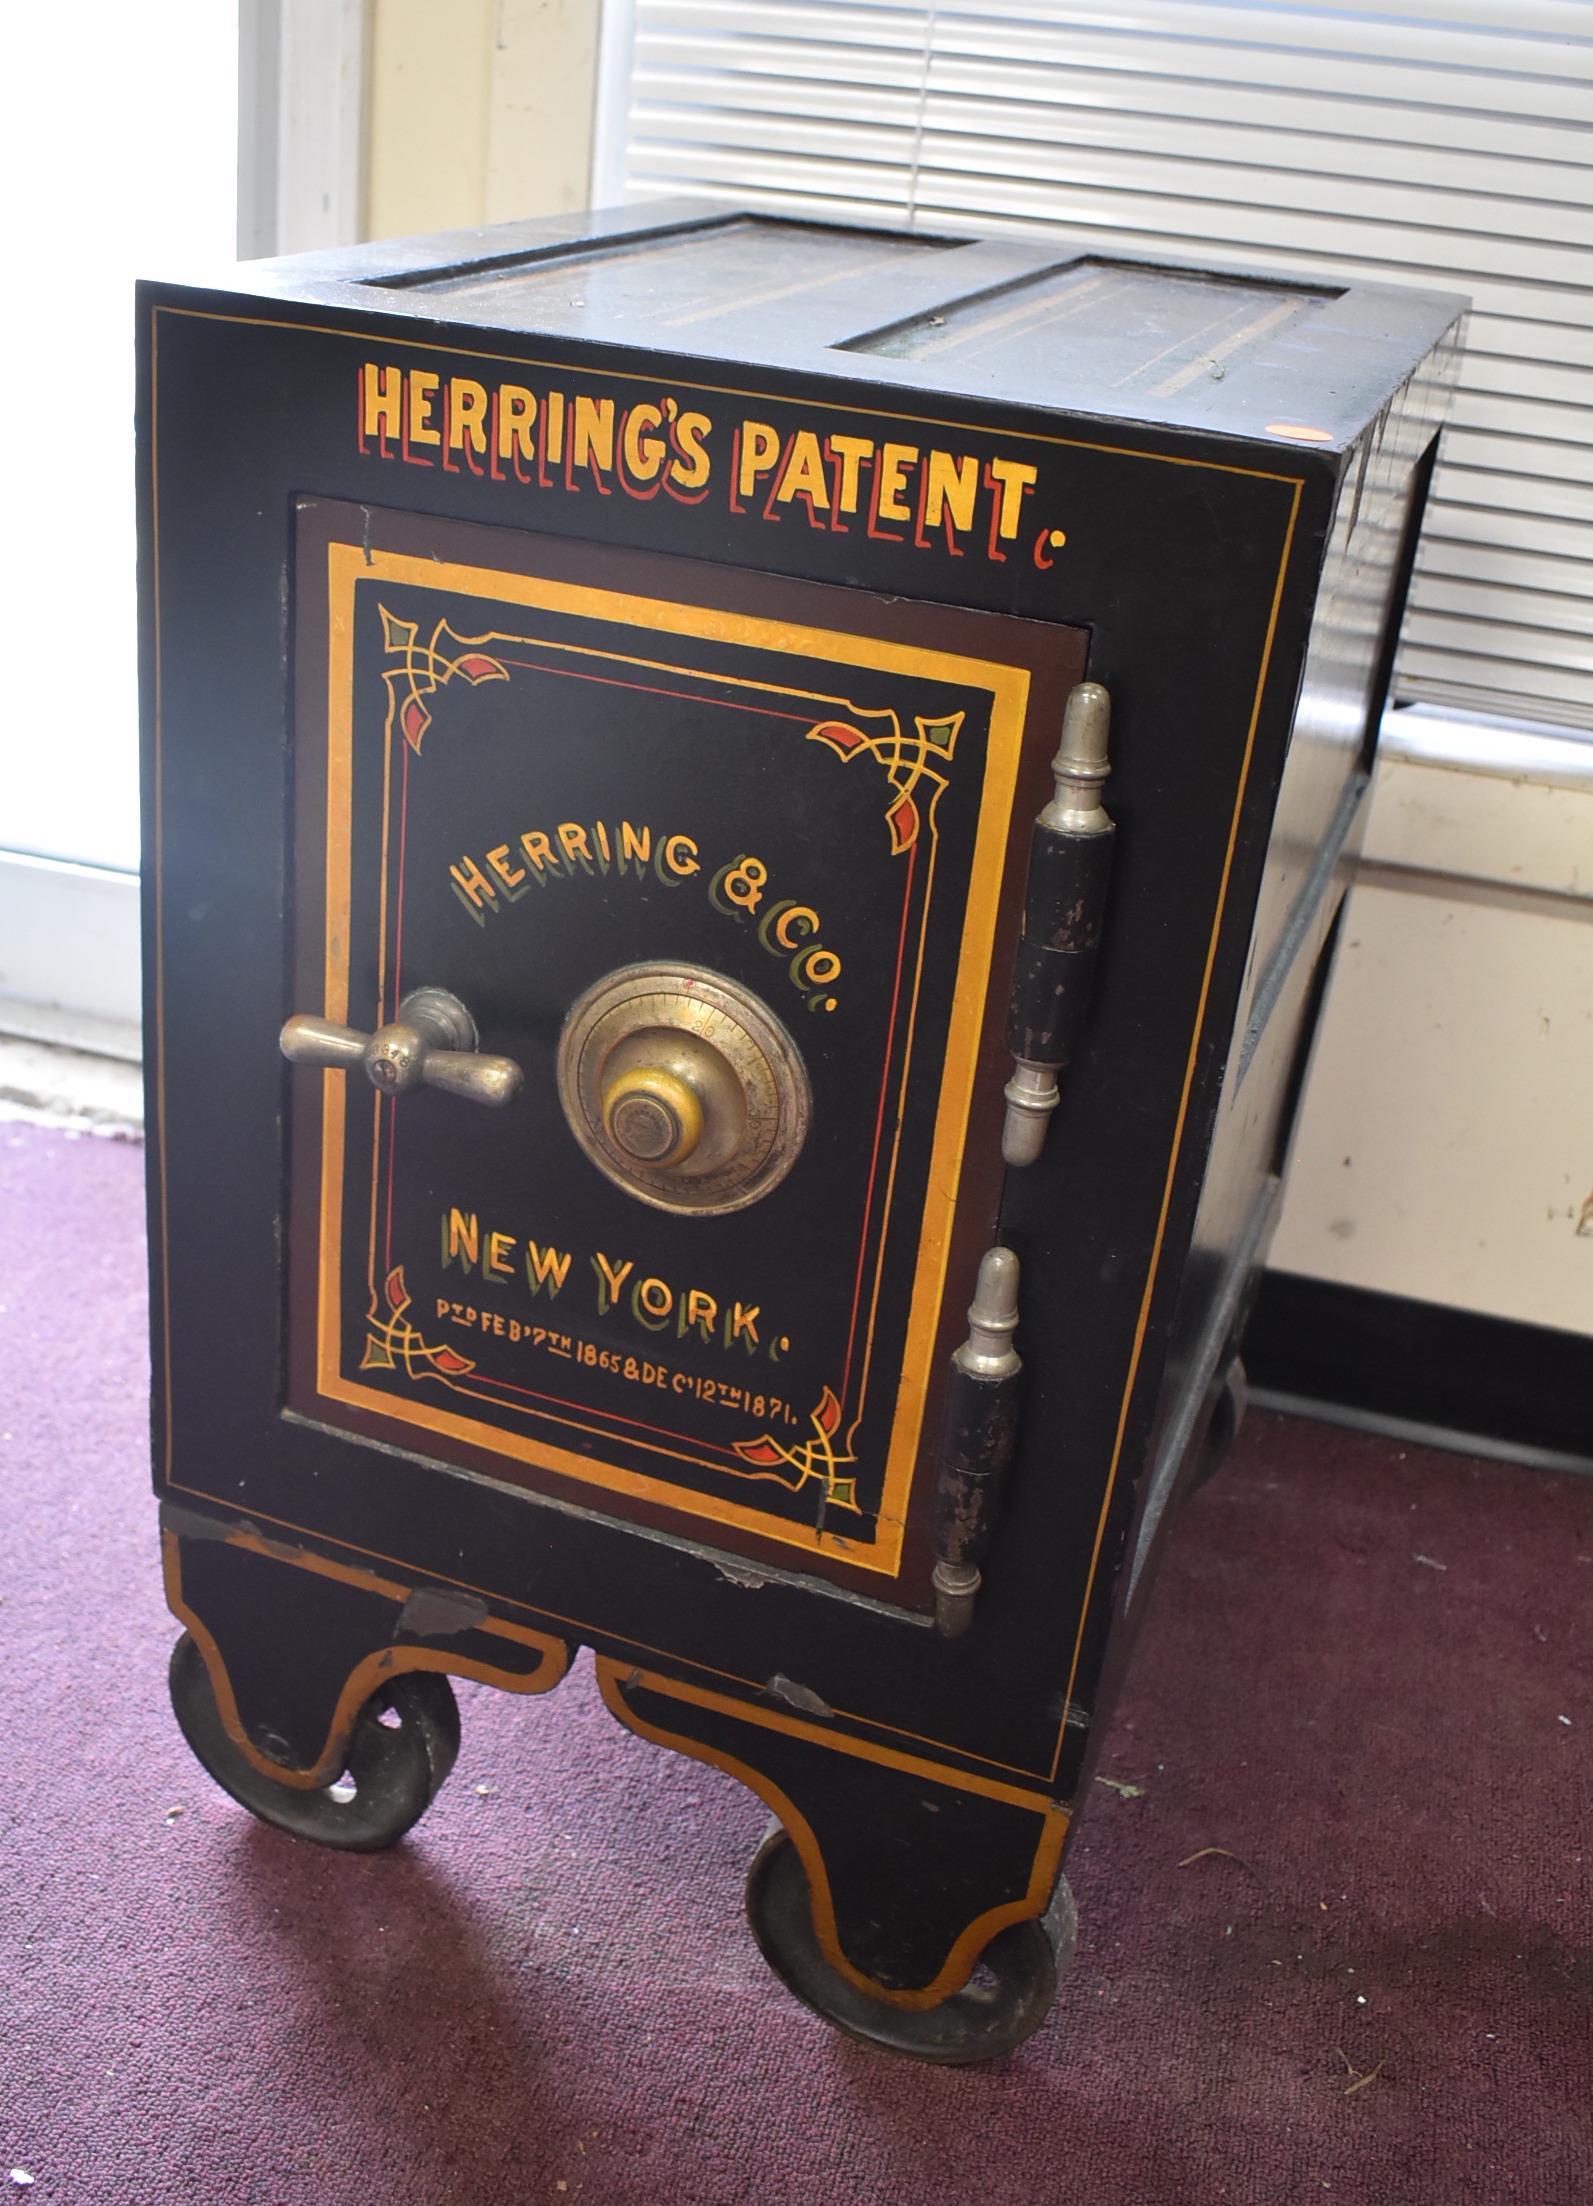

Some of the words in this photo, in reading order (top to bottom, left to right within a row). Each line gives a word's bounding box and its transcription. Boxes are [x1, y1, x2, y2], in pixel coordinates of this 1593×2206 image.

[361, 362, 713, 497] HERRING'S
[449, 820, 701, 910] HERRING
[722, 856, 768, 915] &
[447, 1206, 573, 1290] NEW
[595, 1251, 790, 1353] YORK.
